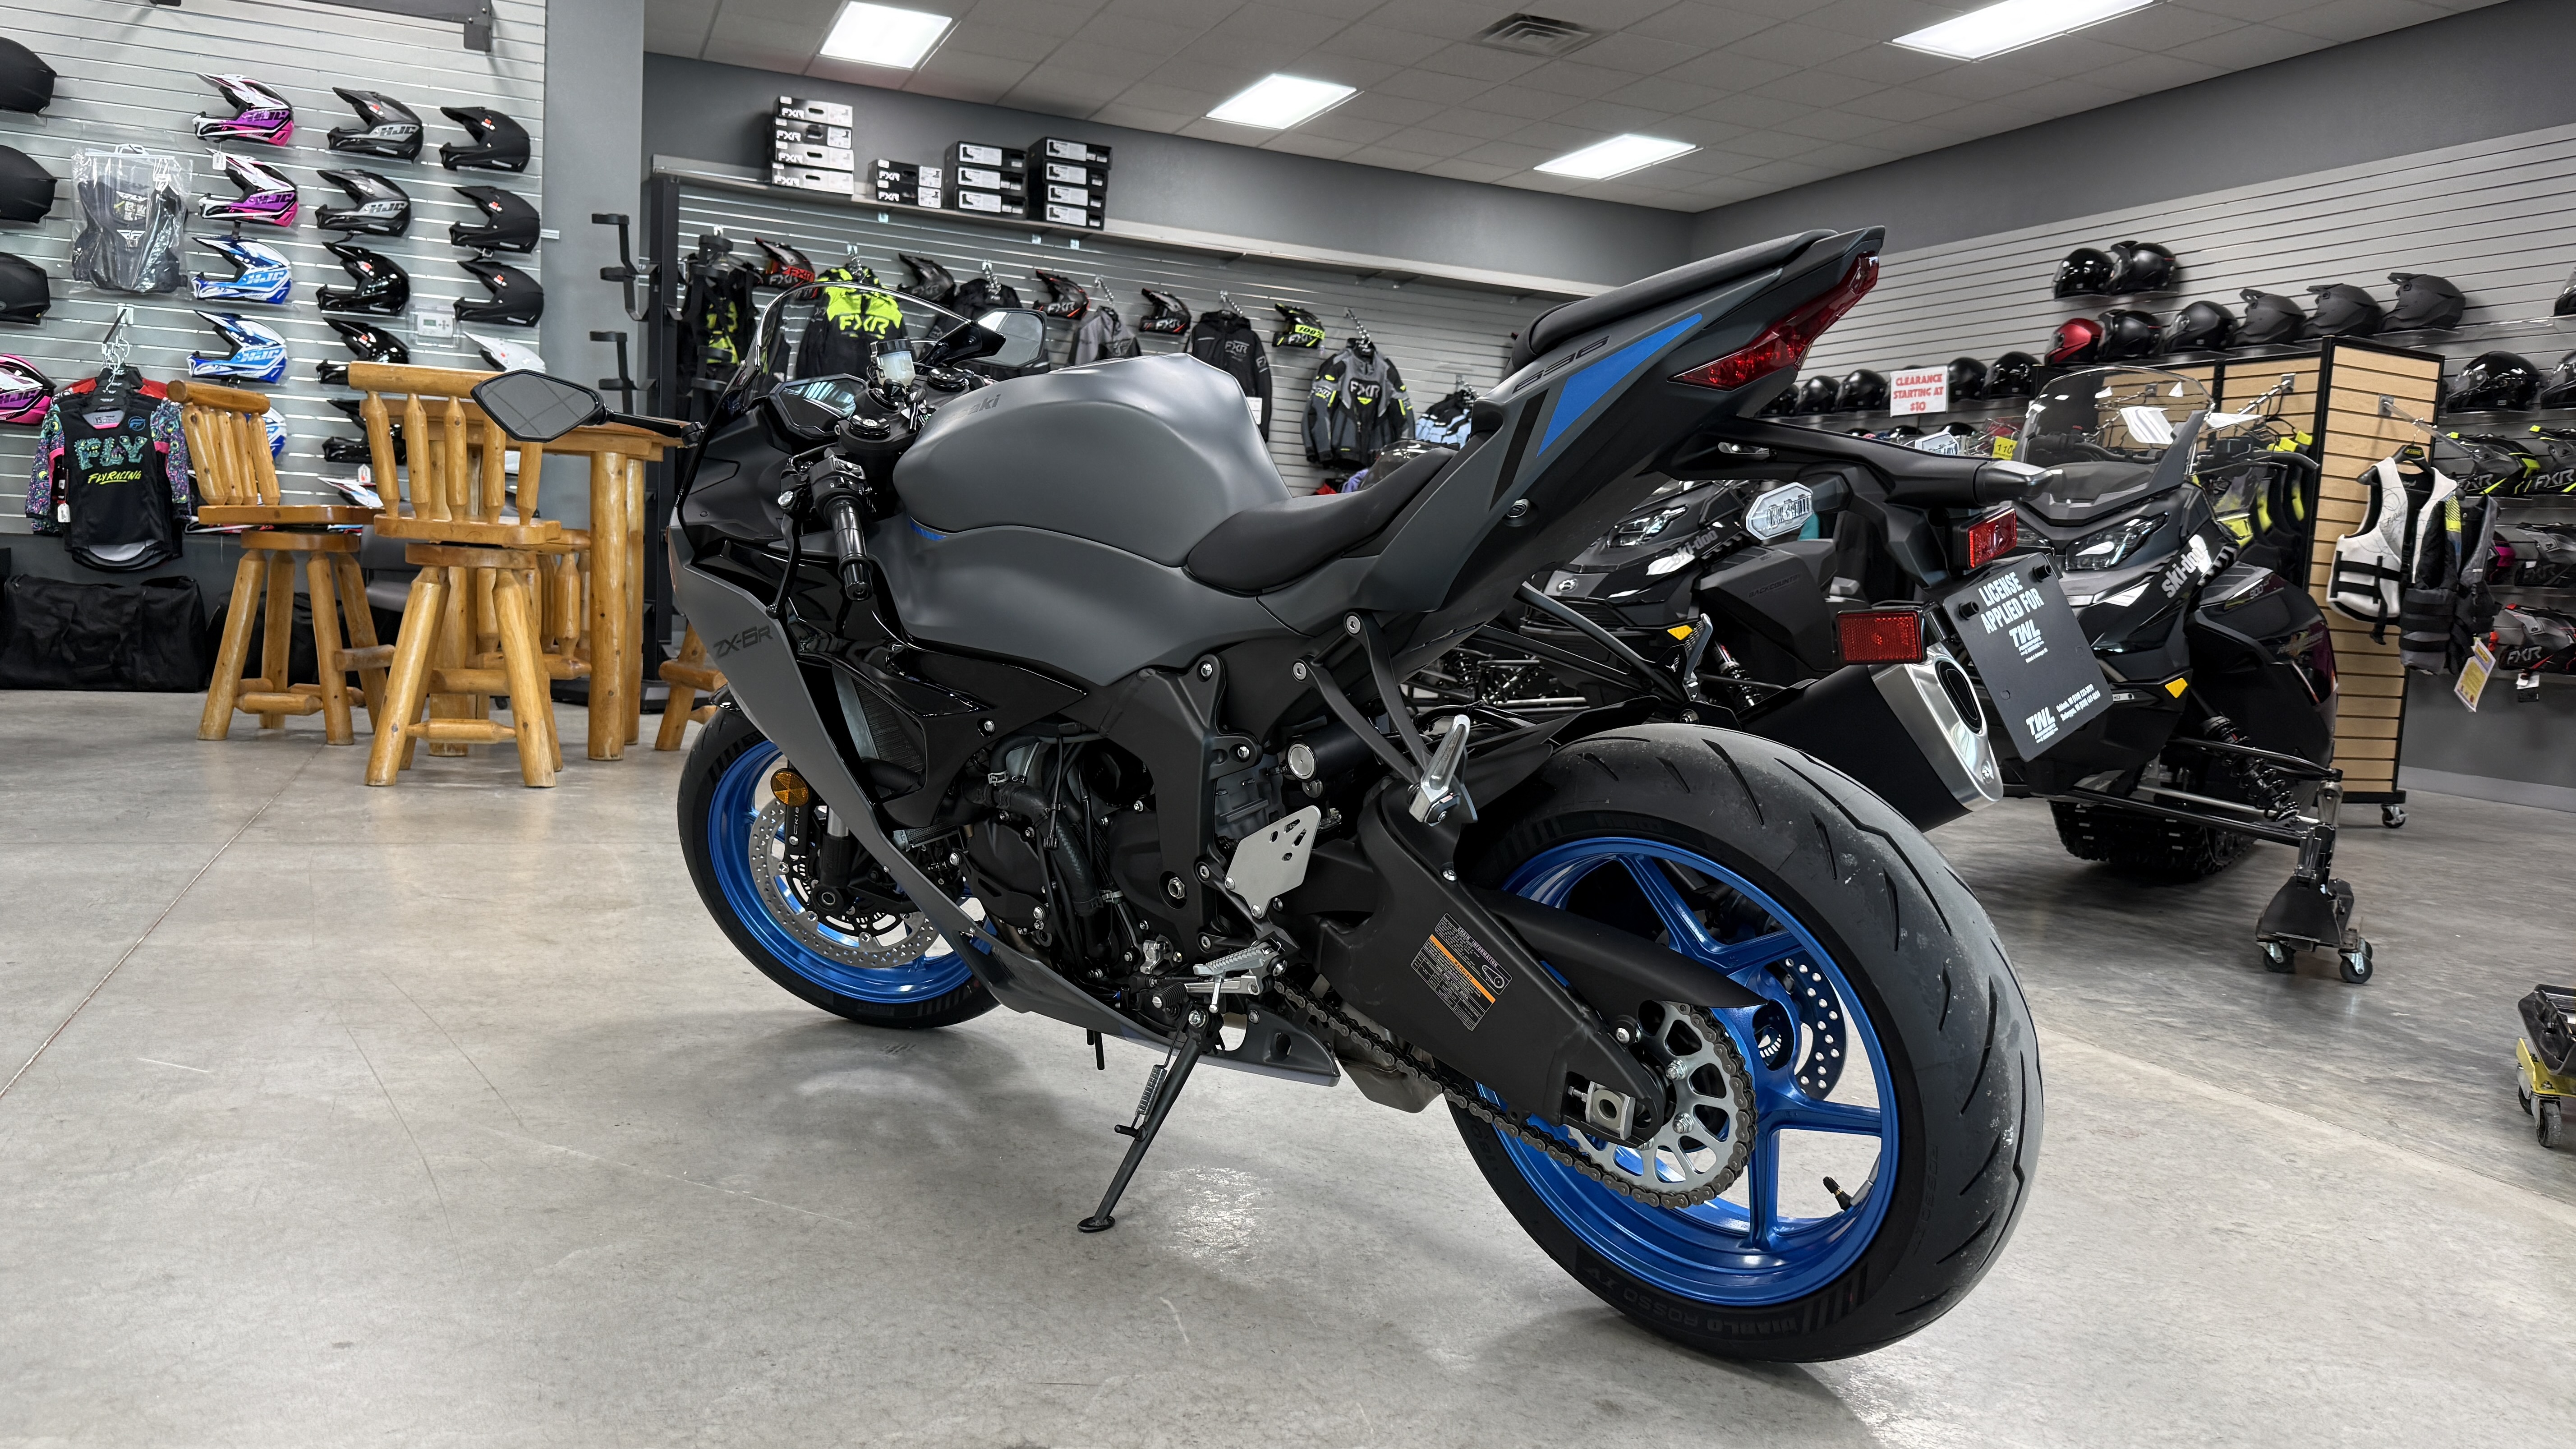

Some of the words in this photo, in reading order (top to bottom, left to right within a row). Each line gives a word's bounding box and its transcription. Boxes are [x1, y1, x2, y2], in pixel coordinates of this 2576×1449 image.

[782, 108, 804, 119] FXR
[380, 125, 417, 136] HJC
[777, 130, 801, 142] FXR
[778, 152, 803, 163] FXR
[774, 175, 800, 186] FXR
[879, 170, 900, 181] FXR
[257, 193, 293, 204] HJC
[878, 191, 899, 202] FXR
[370, 202, 406, 214] HJC
[247, 271, 285, 284] HJC
[789, 268, 812, 280] FXR
[1048, 302, 1075, 313] FXR
[839, 314, 889, 334] FXR
[1225, 341, 1247, 354] FXR
[241, 350, 280, 362] HJC
[1895, 373, 1943, 386] CLEARANCE
[1350, 381, 1380, 398] FXR
[1893, 389, 1931, 399] STARTING
[1932, 386, 1944, 396] AT
[1910, 401, 1926, 411] $10
[74, 436, 148, 470] FLY
[2535, 469, 2574, 490] FXR
[1978, 571, 2024, 607] LICENSE
[1980, 598, 2024, 634] APPLIED
[2019, 588, 2045, 613] FOR
[2009, 619, 2041, 648] TWL
[2507, 646, 2542, 664] FXR
[2025, 707, 2056, 736] TWL
[1457, 926, 1471, 941] CHAIN
[1470, 940, 1498, 968] INFORMATION
[1453, 961, 1473, 980] WARNING
[1435, 964, 1443, 973] TIRE
[1442, 972, 1451, 981] AND
[1450, 980, 1460, 991] LOAD
[1459, 990, 1469, 1000] DATA
[1623, 1288, 1698, 1326] ROSSO
[1707, 1317, 1796, 1334] DIABLO
